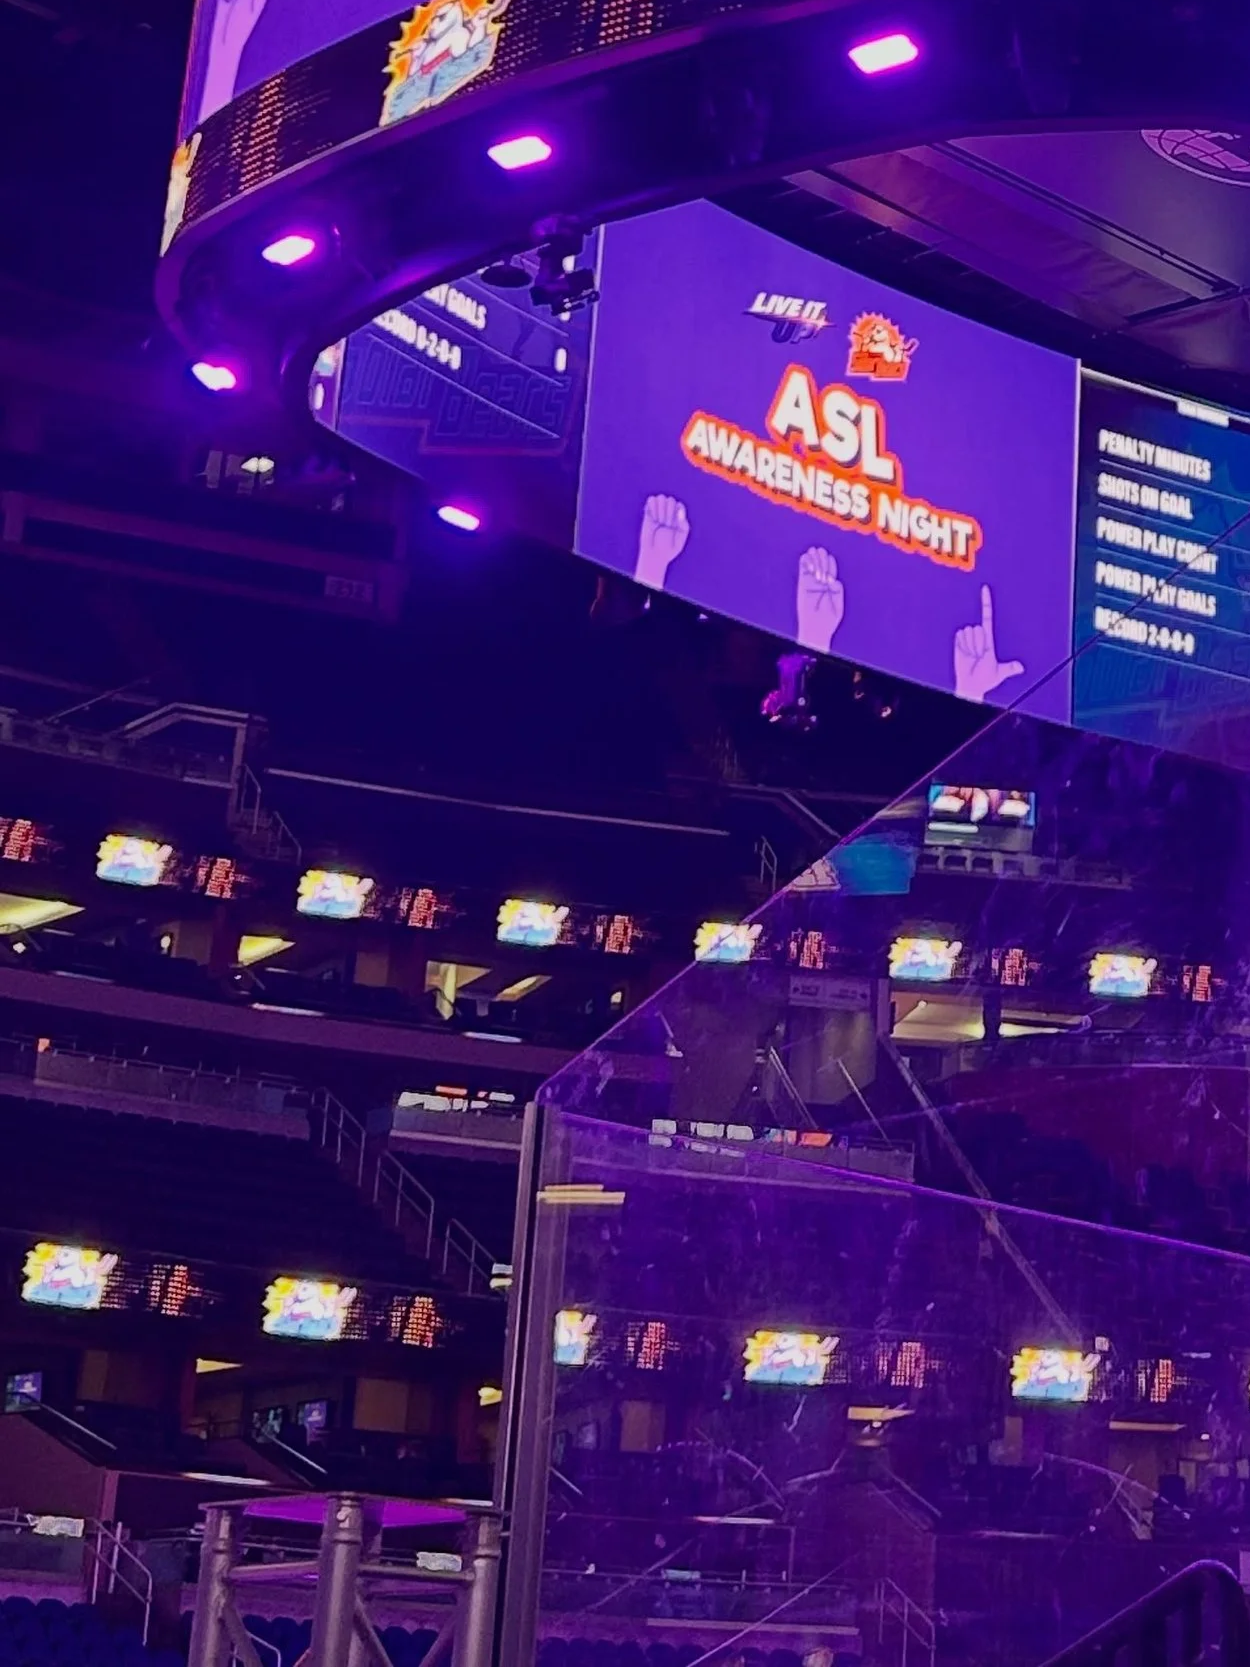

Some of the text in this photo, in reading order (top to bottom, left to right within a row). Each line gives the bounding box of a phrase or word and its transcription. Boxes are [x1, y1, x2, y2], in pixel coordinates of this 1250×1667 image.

[751, 292, 826, 318] LIVE IT
[771, 371, 894, 480] ASL
[1099, 429, 1211, 481] PENALTY MINUTES
[687, 419, 975, 560] AWARENESS NIGHT
[1098, 472, 1193, 520] SHOTS ON GOAL
[1097, 516, 1143, 551] POWER
[1143, 528, 1176, 562] PLAY
[1096, 561, 1216, 617] POWER PLAY GOALS
